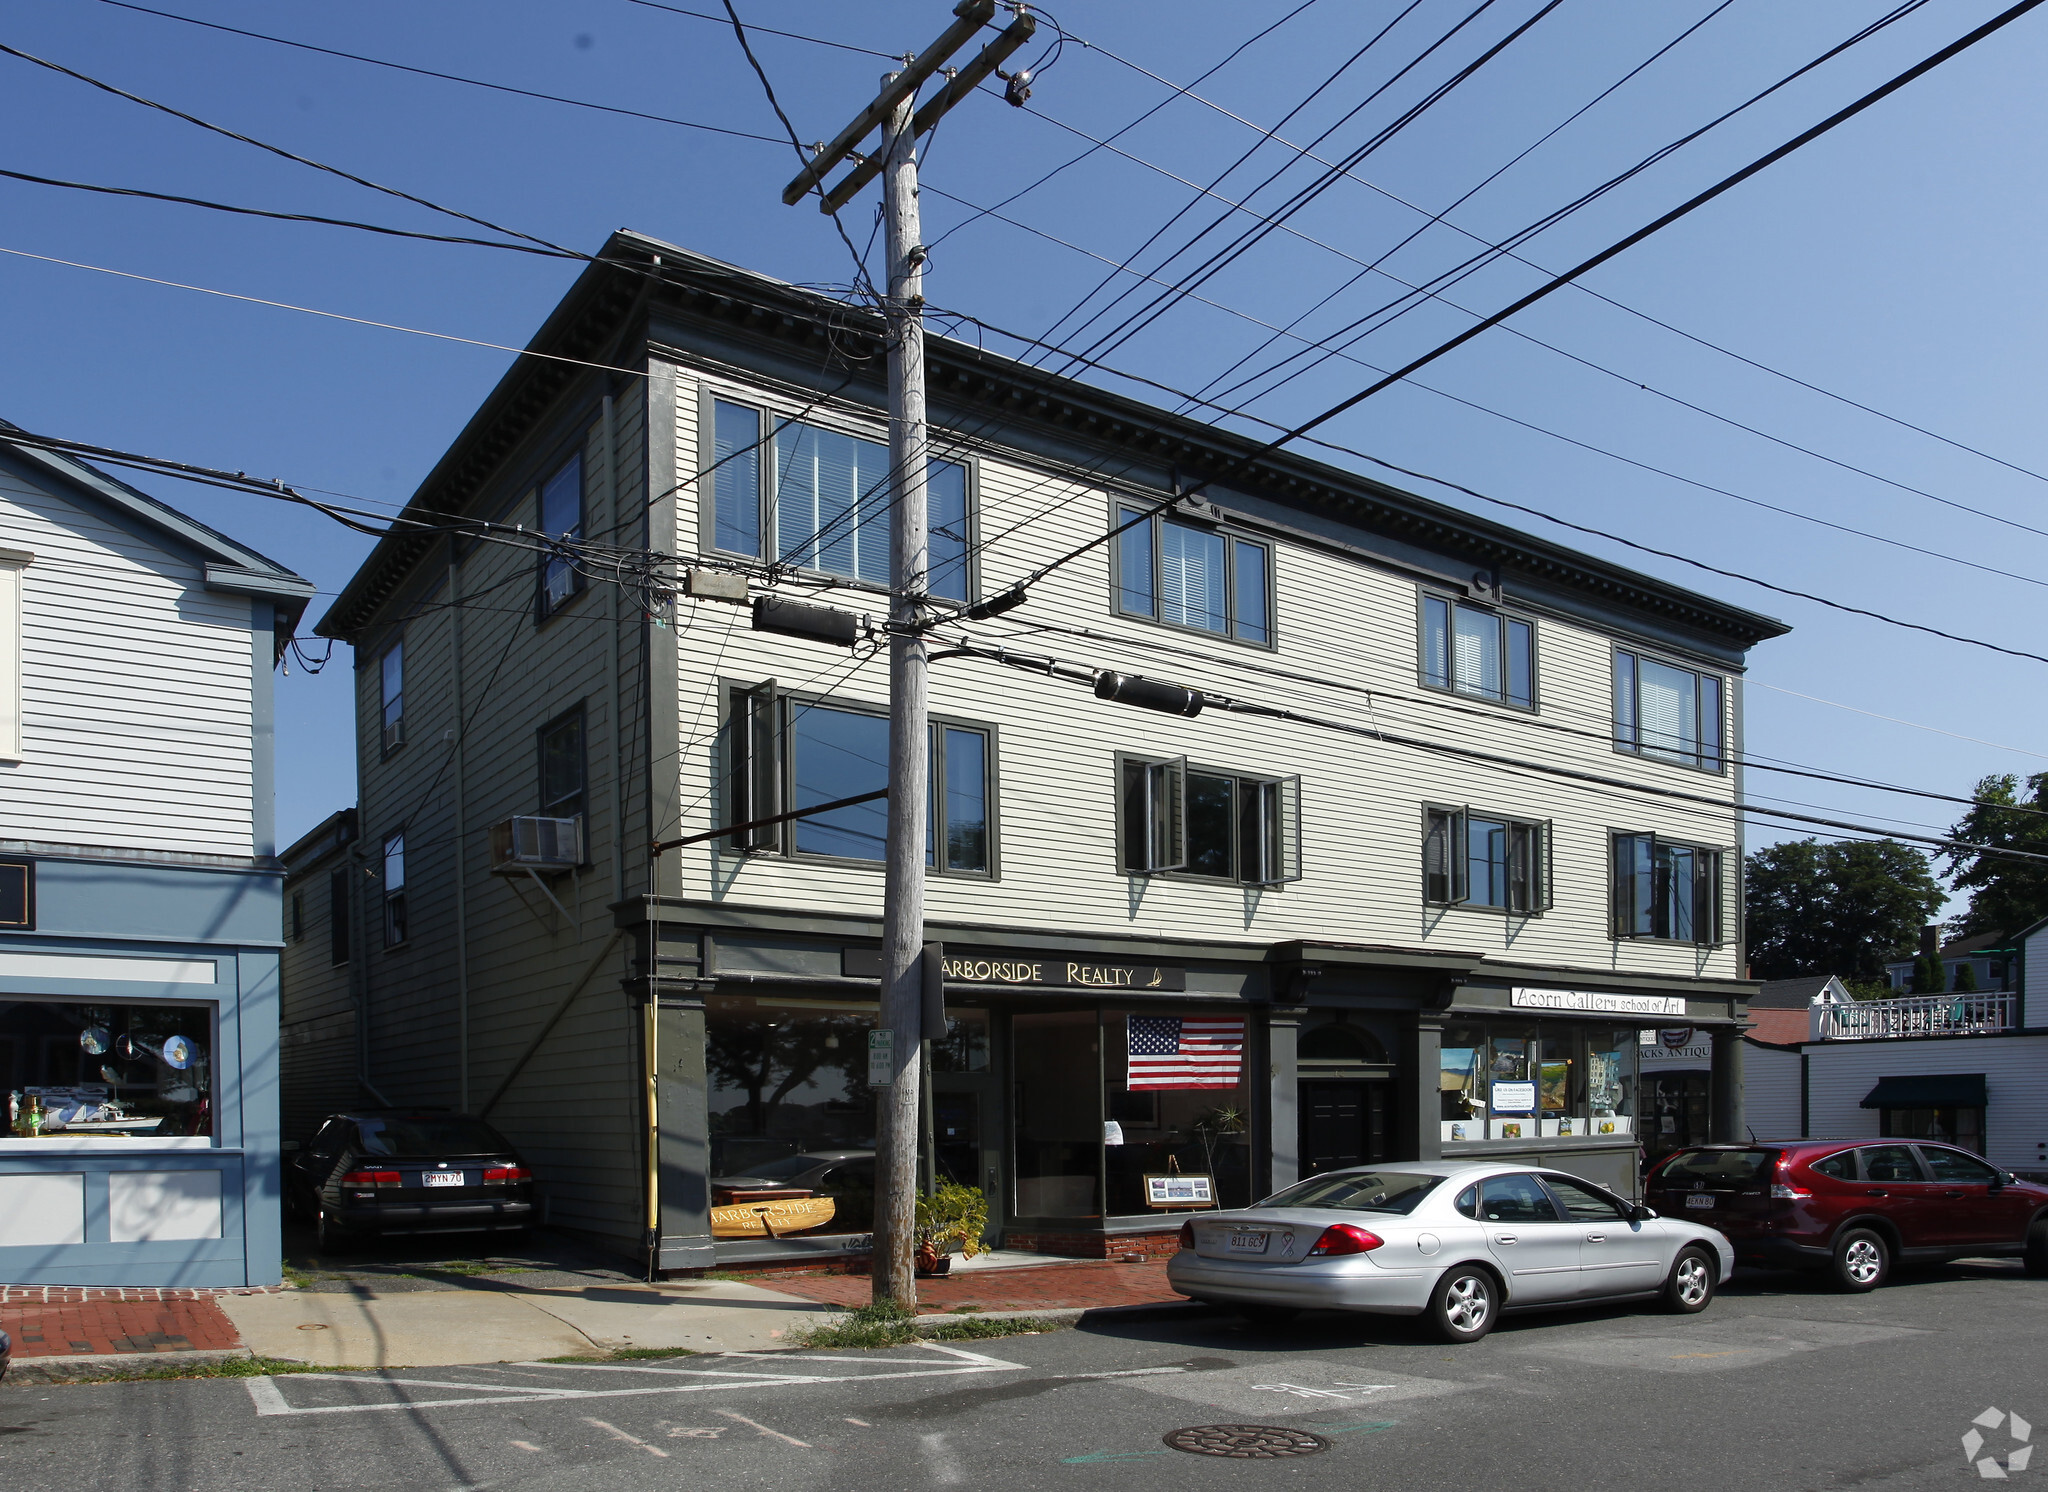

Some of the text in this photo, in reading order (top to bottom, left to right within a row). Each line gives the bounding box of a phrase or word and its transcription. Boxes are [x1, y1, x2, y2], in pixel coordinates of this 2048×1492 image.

[941, 956, 1042, 982] ARBORSIDE
[1516, 988, 1562, 1007] Acorn
[1566, 991, 1617, 1011] Gallery
[1620, 998, 1650, 1012] school
[1651, 1000, 1662, 1012] of
[870, 1032, 876, 1046] 2
[450, 1174, 463, 1183] 70
[1231, 1236, 1246, 1247] 811
